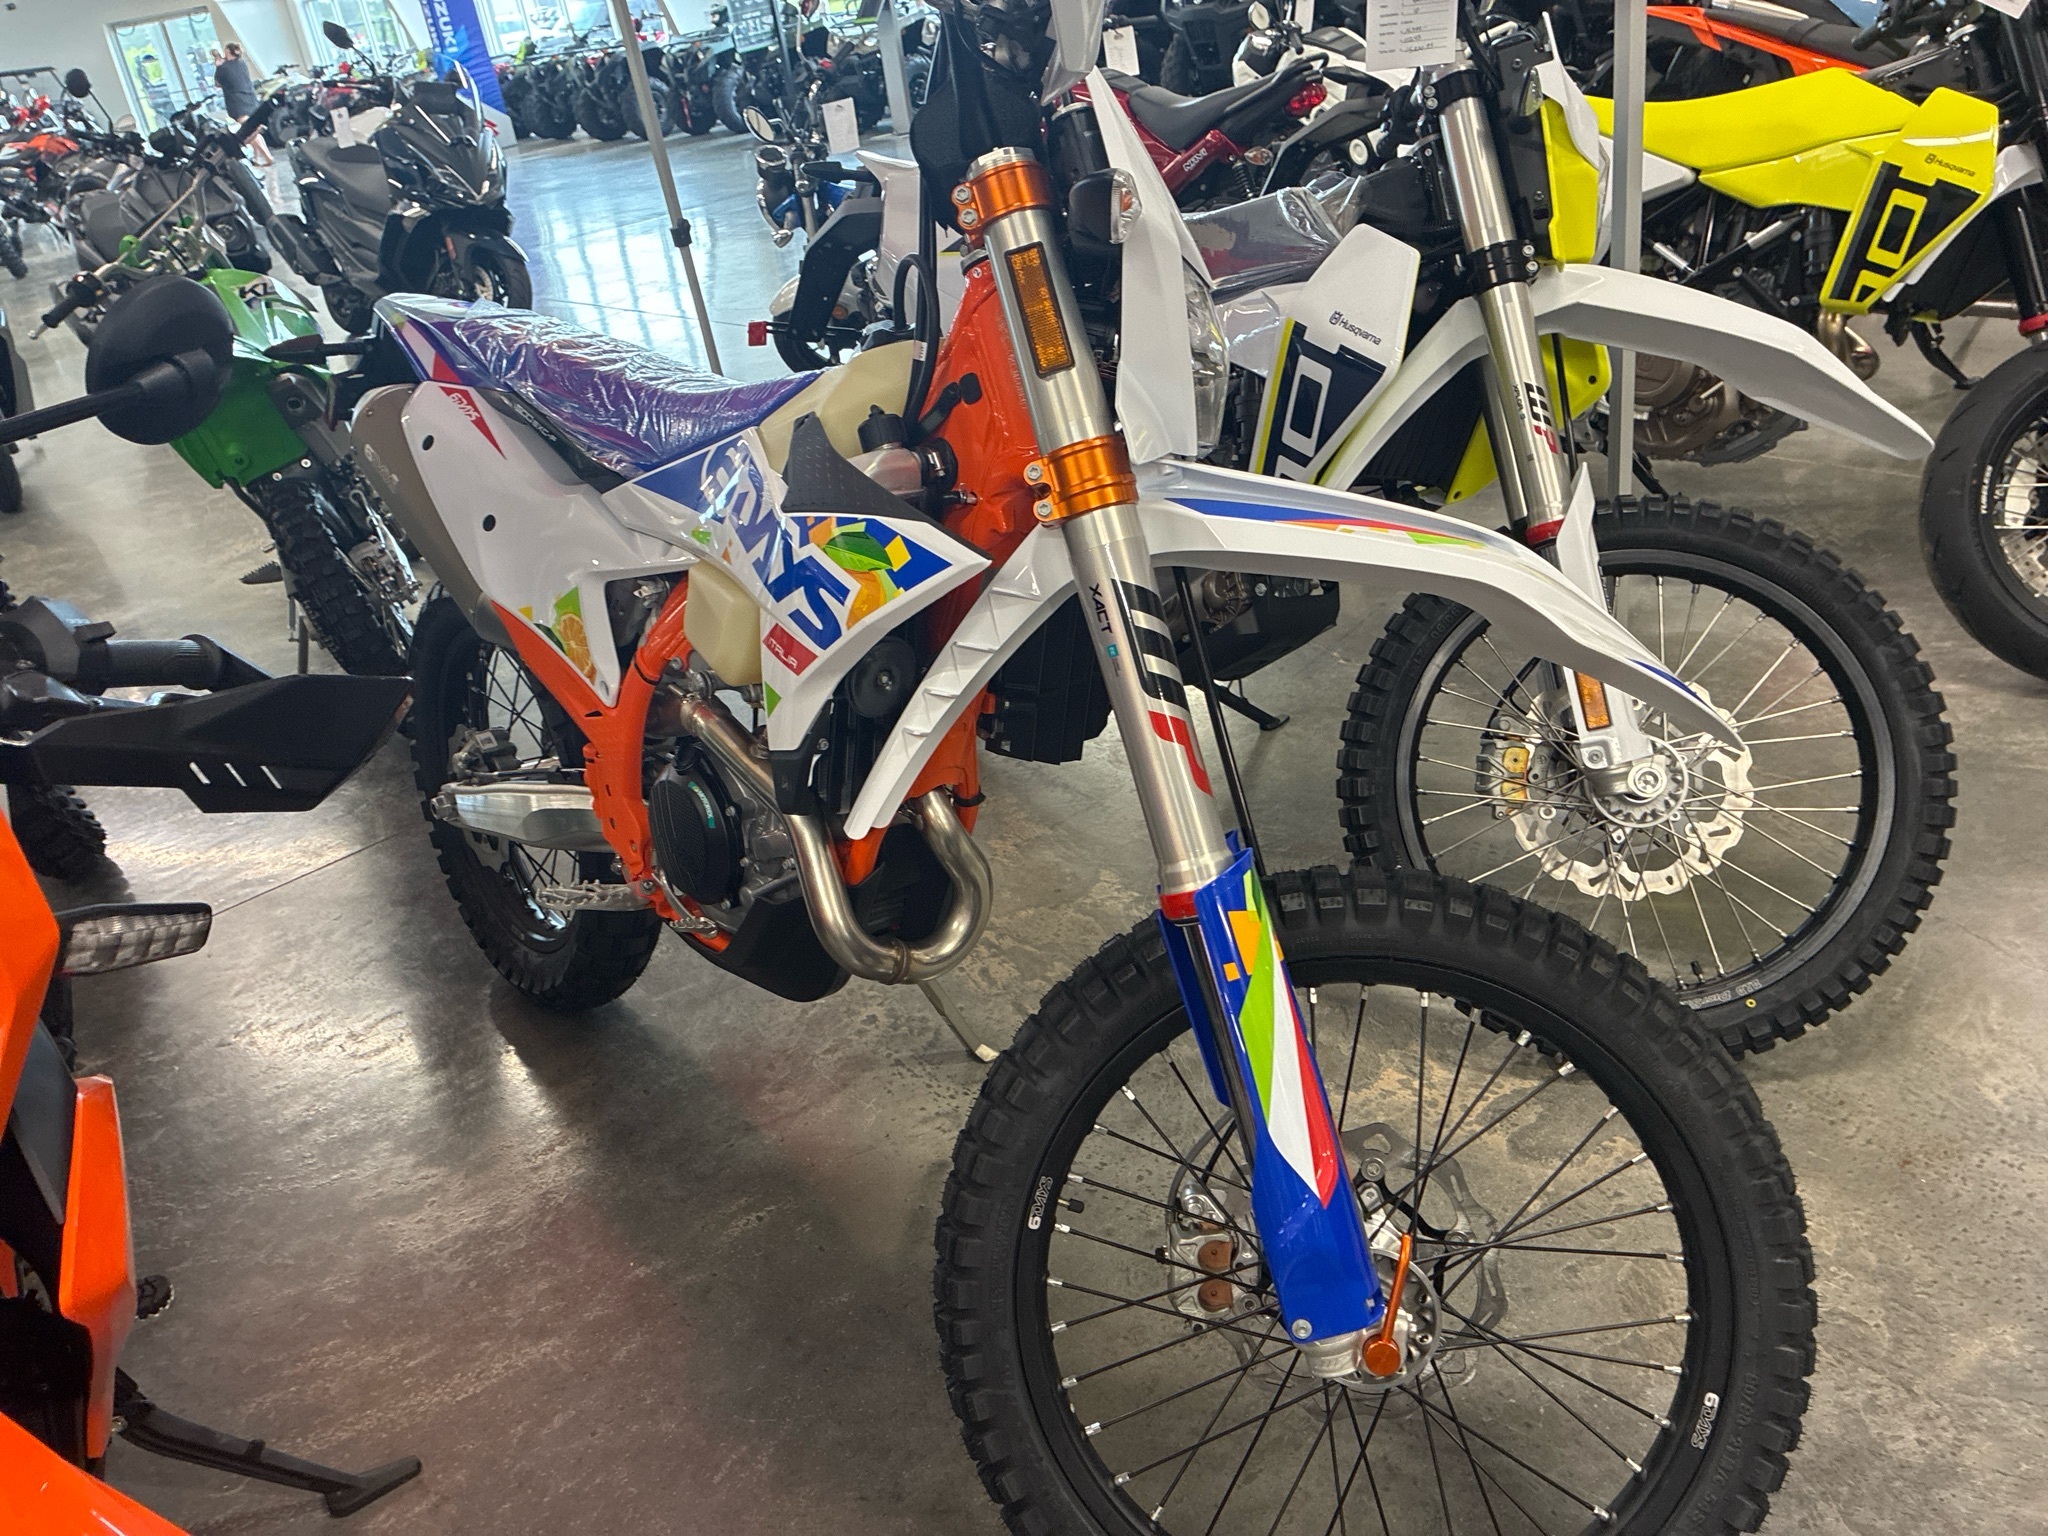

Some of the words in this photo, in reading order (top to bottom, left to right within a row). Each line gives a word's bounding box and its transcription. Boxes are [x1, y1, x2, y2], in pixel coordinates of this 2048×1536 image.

[433, 0, 459, 53] ZUKI
[1935, 158, 1976, 178] Husqvarna
[1338, 316, 1383, 346] Husqvarna
[449, 391, 482, 421] 6DAYS
[1089, 583, 1113, 634] XACT
[767, 635, 799, 671] ITALIA
[1028, 1175, 1053, 1230] 6DAYS
[1691, 1391, 1720, 1450] 6DAYS
